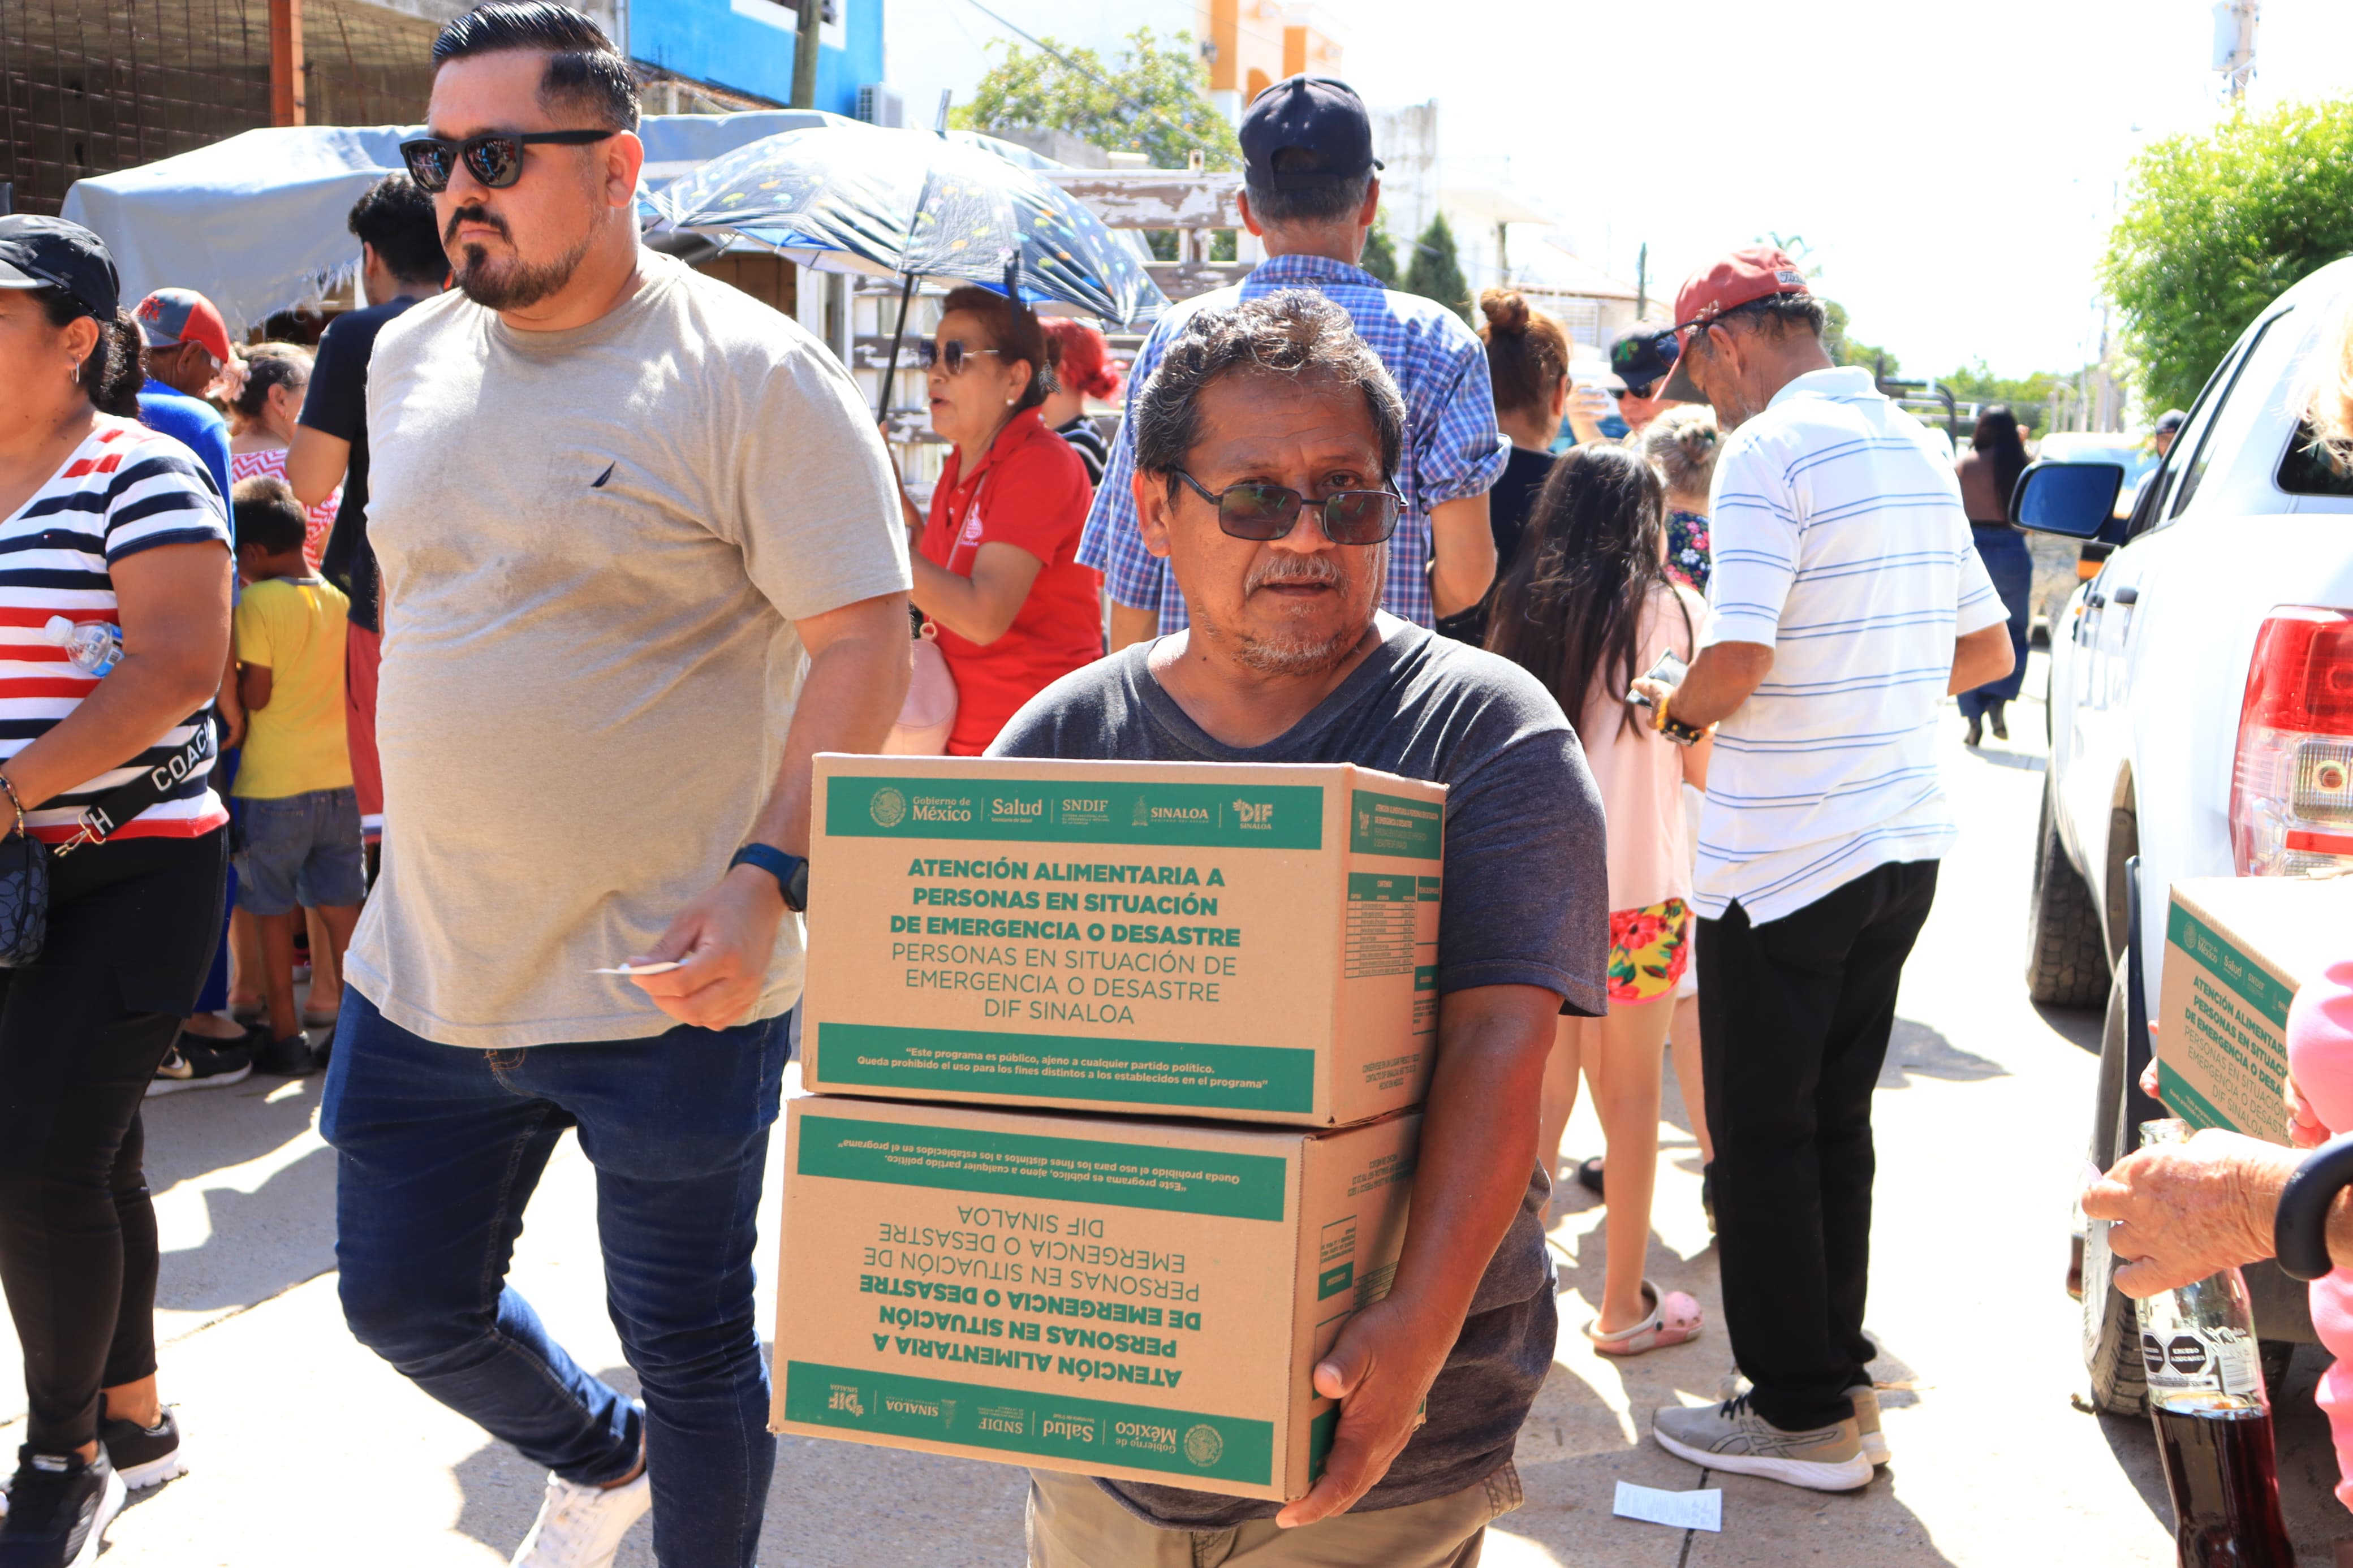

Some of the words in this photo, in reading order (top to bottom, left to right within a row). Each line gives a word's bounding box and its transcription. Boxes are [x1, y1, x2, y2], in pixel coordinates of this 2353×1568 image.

[912, 796, 958, 805] Gobierno
[992, 798, 1043, 816] Salud
[1062, 798, 1109, 812] SNDIF
[89, 806, 115, 835] H
[912, 804, 972, 822] México
[1150, 807, 1209, 819] SINALOA
[1242, 801, 1273, 823] DIF
[908, 856, 1028, 880] ATENCIÓN
[1033, 862, 1200, 886] ALIMENTARIA
[1206, 867, 1225, 887] A
[913, 887, 1040, 910] PERSONAS
[1046, 891, 1079, 911] EN
[1084, 892, 1218, 916] SITUACIÓN
[890, 915, 921, 934] DE
[926, 916, 1081, 940] EMERGENCIA
[1087, 922, 1106, 941] O
[1111, 923, 1241, 947] DESASTRE
[893, 941, 1016, 966] PERSONAS
[1025, 948, 1056, 967] EN
[1066, 949, 1195, 973] SITUACIÓN
[1204, 955, 1236, 977] DE
[2197, 940, 2218, 965] México
[2223, 953, 2242, 978] Salud
[906, 968, 1059, 993] EMERGENCIA
[1067, 976, 1085, 996] O
[1094, 977, 1219, 1003] DESASTRE
[2193, 974, 2234, 1017] ATENCIÓN
[985, 997, 1022, 1017] DIF
[1029, 1000, 1134, 1023] SINALOA
[2194, 995, 2236, 1039] PERSONAS
[2238, 1030, 2249, 1050] EN
[2185, 1007, 2196, 1026] DE
[2197, 1016, 2248, 1071] EMERGENCIA
[2250, 1061, 2257, 1078] O
[856, 1055, 890, 1066] Queda
[890, 1058, 940, 1069] prohibido
[941, 1061, 951, 1070] el
[952, 1063, 971, 1072] uso
[972, 1064, 996, 1073] para
[997, 1064, 1013, 1074] los
[1014, 1065, 1040, 1075] fines
[1041, 1066, 1087, 1078] distintos
[1088, 1070, 1096, 1079] a
[1096, 1070, 1113, 1080] los
[1114, 1072, 1180, 1084] establecidos
[1181, 1076, 1196, 1085] en
[1197, 1076, 1208, 1085] el
[934, 1050, 984, 1060] programa
[998, 1053, 1040, 1064] público,
[1041, 1056, 1070, 1066] ajeno
[1080, 1058, 1129, 1069] cualquier
[1130, 1061, 1170, 1072] partido
[1171, 1063, 1215, 1074] político.
[2184, 1024, 2226, 1071] PERSONAS
[2229, 1061, 2239, 1082] EN
[2241, 1072, 2287, 1124] SITUACIÓN
[2188, 1044, 2239, 1100] EMERGENCIA
[2242, 1091, 2247, 1108] O
[2212, 1083, 2225, 1105] DIF
[2227, 1096, 2264, 1139] SINALOA
[890, 1143, 901, 1152] el
[915, 1146, 978, 1159] establecidos
[979, 1152, 995, 1161] los
[885, 1155, 924, 1166] político.
[925, 1158, 962, 1169] partido
[963, 1163, 1010, 1173] cualquier
[1004, 1154, 1049, 1167] distintos
[1011, 1166, 1018, 1174] a
[1050, 1158, 1076, 1170] fines
[1076, 1160, 1093, 1171] los
[1093, 1162, 1118, 1172] para
[1118, 1164, 1138, 1173] uso
[1019, 1167, 1048, 1177] ajeno
[1049, 1169, 1092, 1181] público,
[1092, 1173, 1105, 1182] es
[1105, 1175, 1157, 1187] programa
[1139, 1167, 1150, 1176] el
[1151, 1167, 1204, 1180] prohibido
[1204, 1172, 1240, 1185] Queda
[958, 1206, 1059, 1234] SINALOA
[1067, 1218, 1104, 1238] DIF
[880, 1223, 996, 1254] DESASTRE
[1004, 1236, 1021, 1256] O
[865, 1247, 893, 1268] DE
[901, 1252, 1023, 1282] SITUACIÓN
[1031, 1240, 1186, 1273] EMERGENCIA
[1031, 1266, 1062, 1286] EN
[1071, 1269, 1199, 1302] PERSONAS
[860, 1273, 978, 1305] DESASTRE
[984, 1289, 1001, 1307] O
[1007, 1290, 1163, 1327] EMERGENCIA
[880, 1305, 1004, 1337] SITUACIÓN
[1169, 1309, 1202, 1331] DE
[1009, 1320, 1041, 1342] EN
[1046, 1325, 1177, 1358] PERSONAS
[873, 1333, 890, 1351] A
[895, 1336, 1053, 1372] ALIMENTARIA
[1058, 1356, 1182, 1388] ATENCIÓN
[828, 1392, 857, 1414] DIF
[886, 1400, 939, 1416] SINALOA
[979, 1417, 1023, 1434] SNDIF
[1042, 1419, 1094, 1443] Salud
[1114, 1421, 1177, 1446] México
[1115, 1439, 1128, 1448] de
[1129, 1440, 1177, 1454] Gobierno
